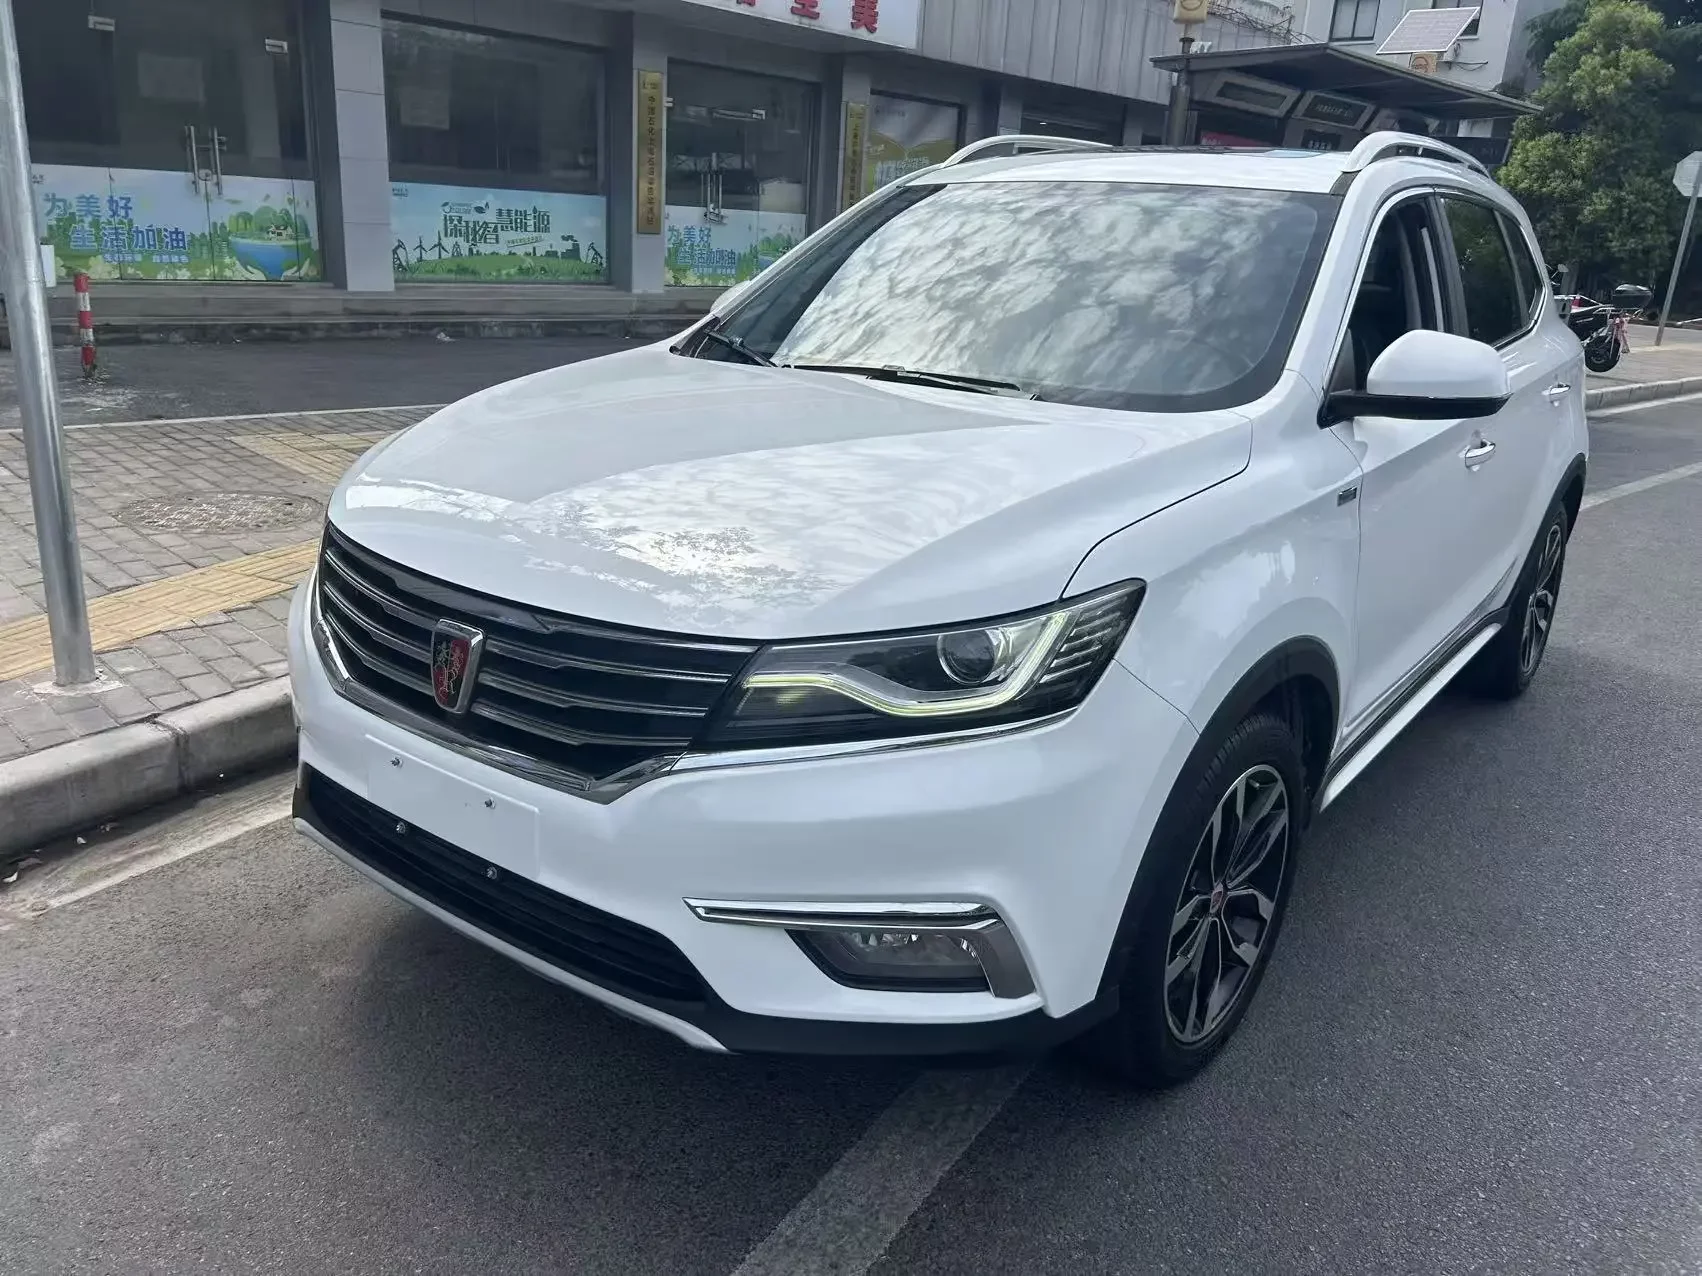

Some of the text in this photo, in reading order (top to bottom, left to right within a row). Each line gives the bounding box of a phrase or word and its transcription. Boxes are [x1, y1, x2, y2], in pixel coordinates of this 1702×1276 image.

[43, 192, 133, 220] 为美好
[69, 223, 188, 251] 生活加油
